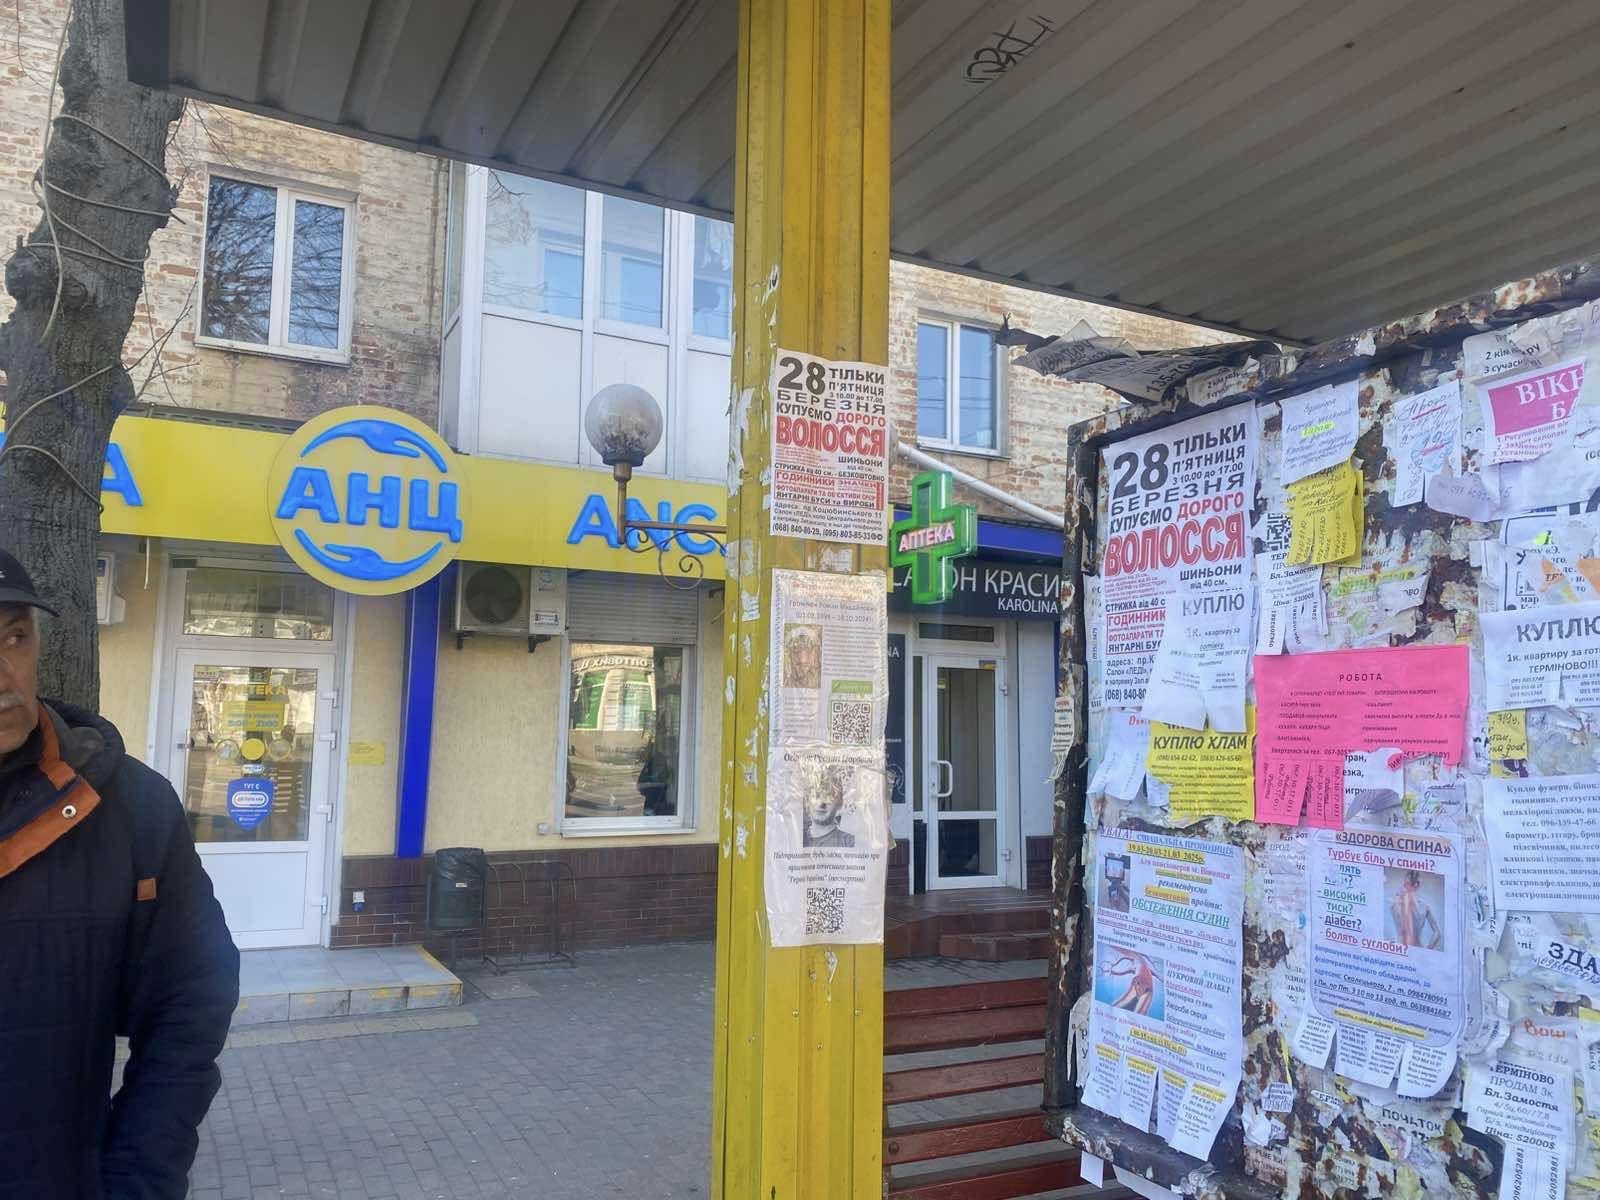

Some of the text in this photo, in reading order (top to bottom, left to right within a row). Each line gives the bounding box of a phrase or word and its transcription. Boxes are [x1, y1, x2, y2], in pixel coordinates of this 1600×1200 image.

[778, 357, 826, 396] 28
[829, 368, 885, 385] ТІЛЬКИ
[829, 382, 884, 402] П'ЯТНИЦЯ
[777, 390, 886, 415] БЕРЕЗНЯ
[776, 401, 887, 428] КУПУЄМО ДОРОГО
[775, 415, 887, 459] ВОЛОССЯ
[1173, 422, 1246, 457] ТІЛЬКИ
[774, 463, 805, 472] СТРИЖКА
[838, 456, 883, 468] ШИНЬОНИ
[1172, 445, 1245, 475] П'ЯТНИЦЯ
[776, 471, 835, 486] ГОДИННИКИ
[1113, 443, 1169, 500] 28
[1180, 471, 1202, 484] 10.00
[1203, 469, 1216, 480] до
[1218, 462, 1243, 476] 17.00
[1111, 472, 1245, 516] БЕРЕЗНЯ
[275, 466, 463, 544] АНЦ
[1110, 491, 1244, 535] КУПУЄМО ДОРОГО
[898, 520, 955, 552] АПТЕКА
[1103, 510, 1247, 577] ВОЛОССЯ
[1179, 563, 1242, 581] ШИНЬОНИ
[984, 568, 1060, 599] КРАСИ
[997, 597, 1059, 614] KAROLINA
[1105, 597, 1159, 612] СТРИЖКА від 40
[1182, 593, 1245, 617] КУПЛЮ
[1108, 630, 1153, 642] ФОТОАПАРАТИ
[1108, 642, 1144, 653] ЯНТАРНІ
[1524, 650, 1569, 664] квартиру
[1571, 648, 1582, 657] за
[1528, 658, 1599, 675] ТЕРМІНОВО!!!
[1339, 672, 1384, 682] РОБОТА
[1105, 688, 1122, 701] (068)
[1153, 735, 1248, 750] КУПЛЮ ХЛАМ
[1335, 831, 1450, 855] «ЗДОРОВА СПИНА»
[1328, 847, 1361, 861] Турбує
[1364, 851, 1386, 864] біль
[1397, 856, 1435, 871] спині?
[1324, 888, 1366, 903] високий
[1131, 896, 1194, 919] ОБСТЕЖЕННЯ
[1326, 900, 1354, 914] тиск?
[1325, 915, 1362, 931] діабет?
[1325, 929, 1409, 955] болять суглоби?
[1489, 1075, 1538, 1095] ПРОДАМ
[1484, 1126, 1514, 1141] Ціна:
